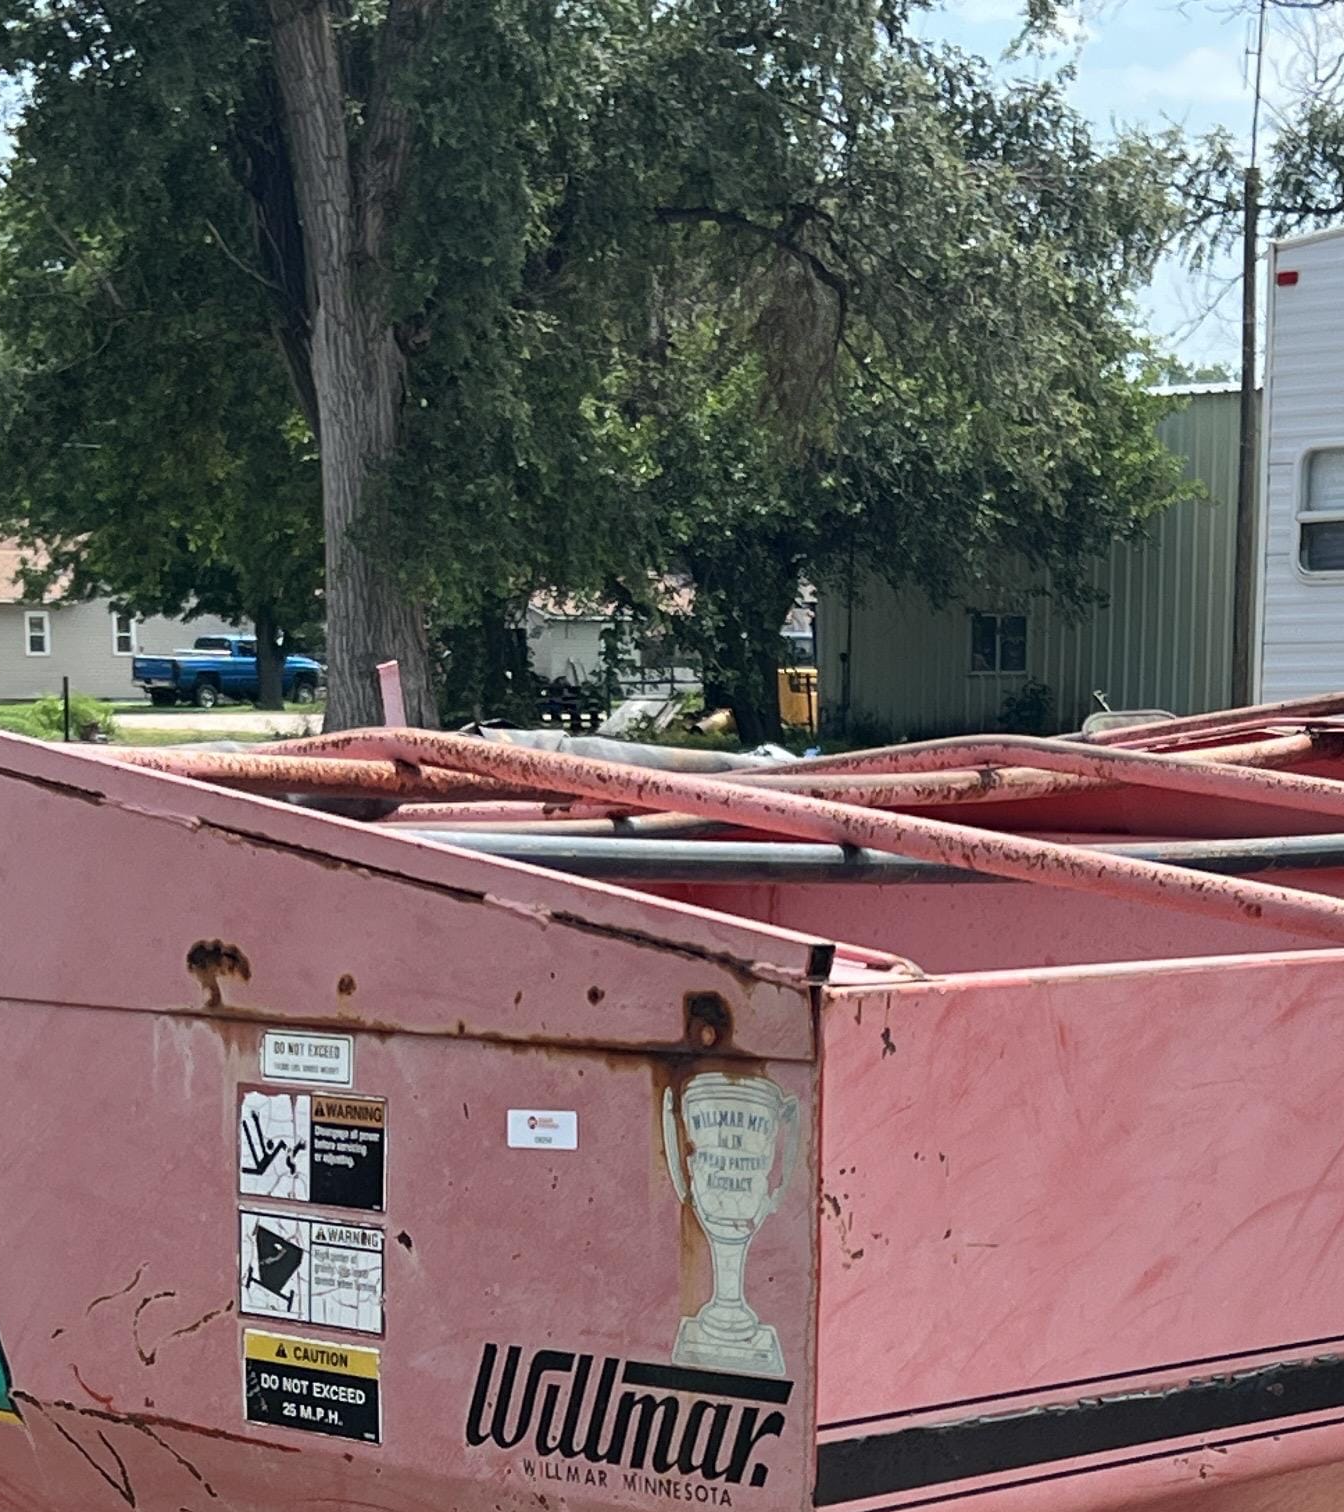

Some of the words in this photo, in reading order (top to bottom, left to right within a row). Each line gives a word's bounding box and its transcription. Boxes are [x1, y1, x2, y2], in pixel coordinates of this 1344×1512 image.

[273, 1041, 285, 1054] DO
[287, 1042, 304, 1056] NOT
[307, 1043, 340, 1060] EXCEED
[325, 1102, 382, 1123] WARNING
[692, 1110, 744, 1130] WILLMAR
[293, 1346, 348, 1368] CAUTION
[260, 1373, 278, 1391] DO
[282, 1376, 309, 1395] NOT
[312, 1381, 366, 1404] EXCEED
[282, 1402, 296, 1417] 25
[299, 1405, 344, 1426] M.P.H.
[523, 1458, 607, 1489] WILLMAR
[623, 1473, 733, 1508] MINNESOTA
